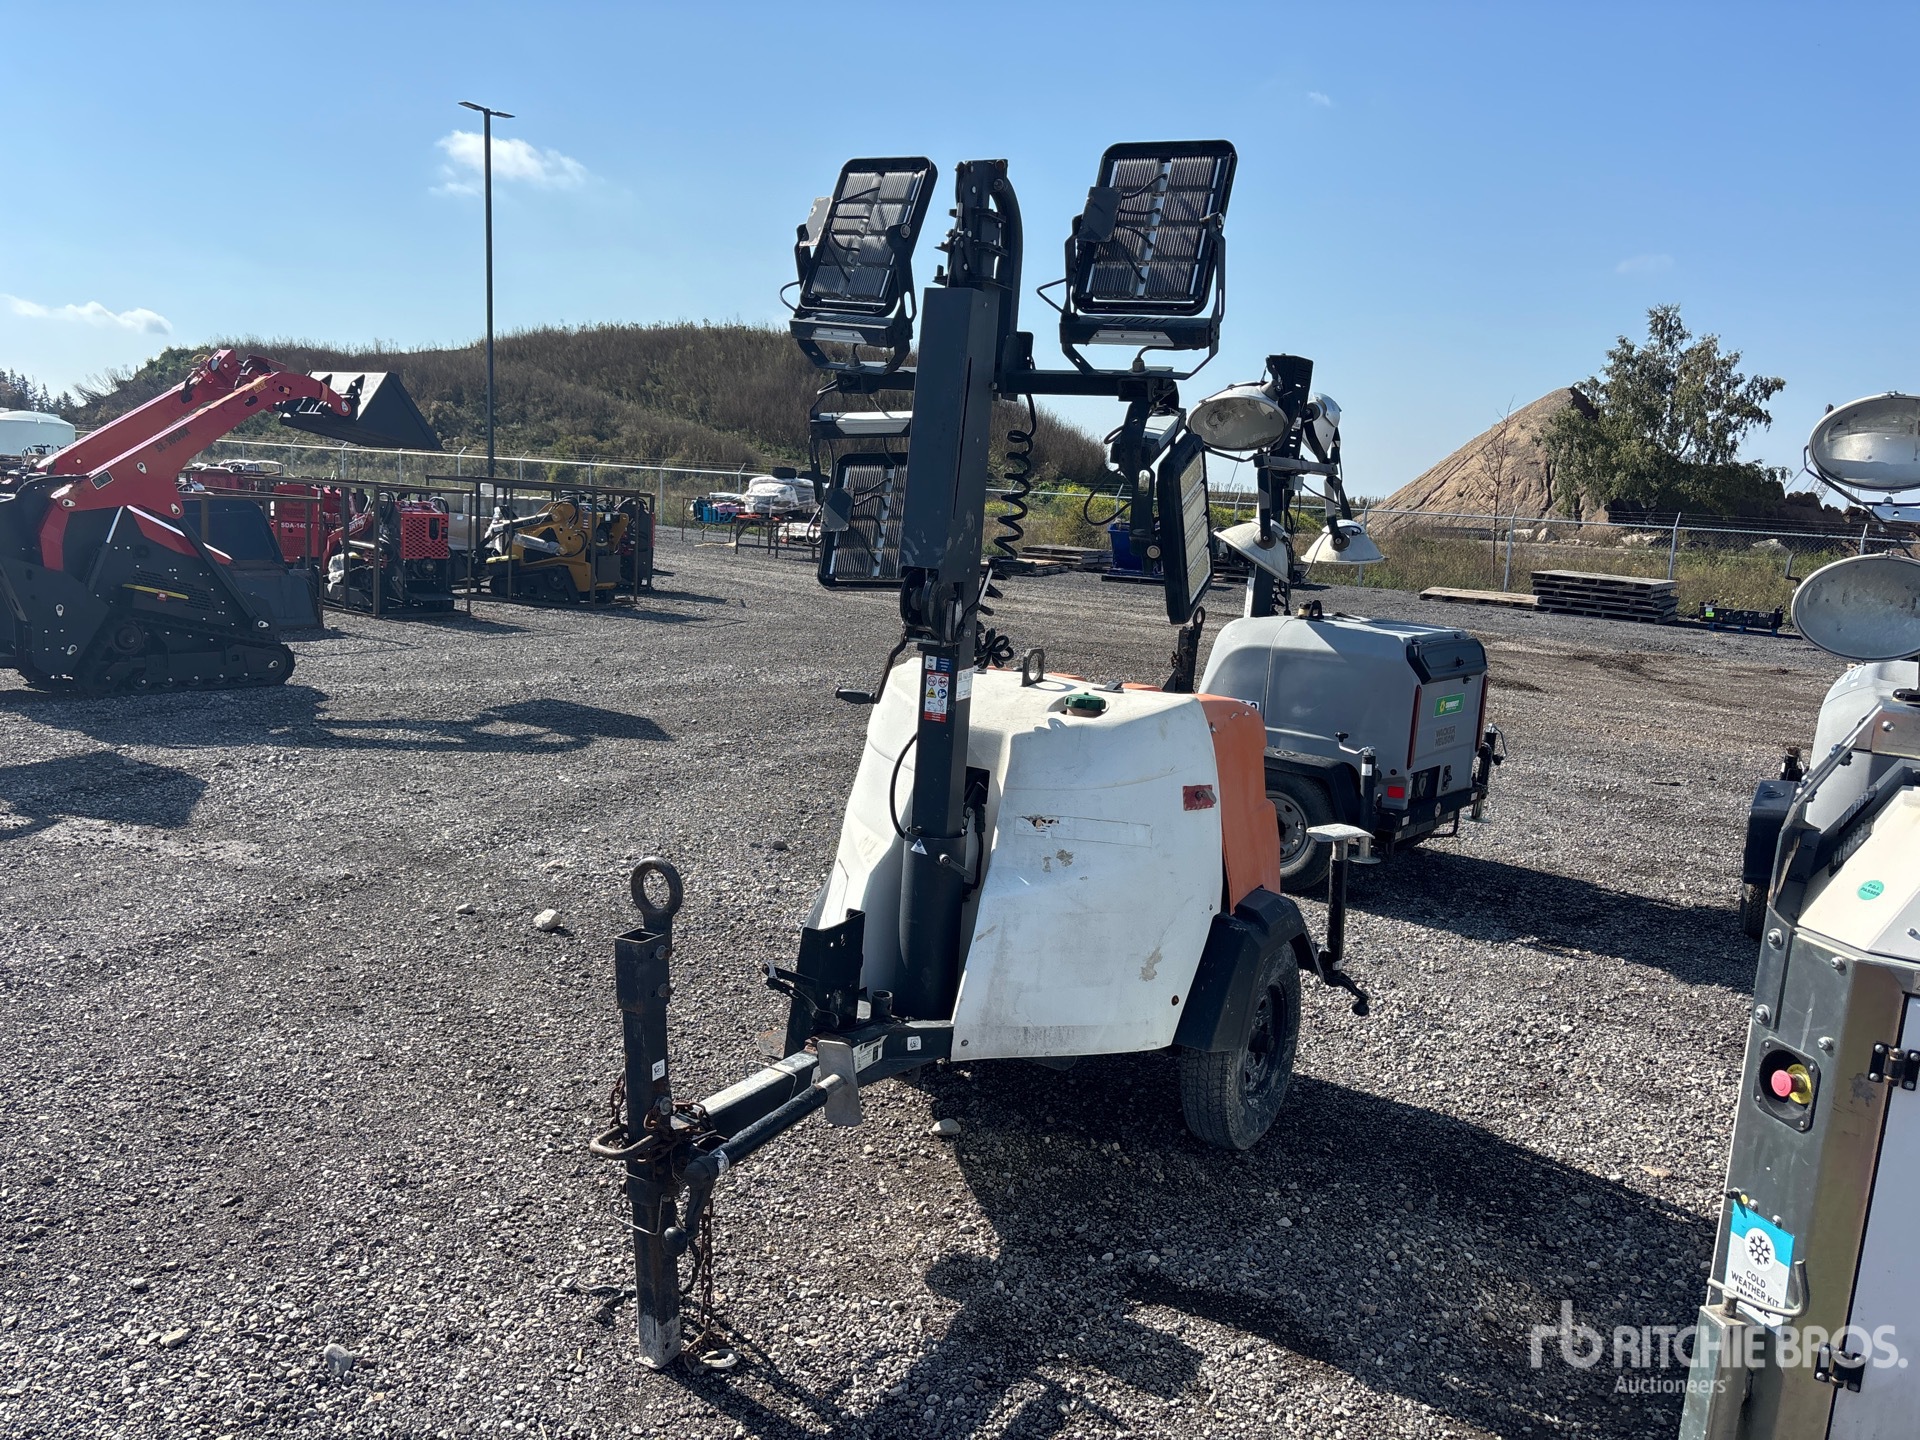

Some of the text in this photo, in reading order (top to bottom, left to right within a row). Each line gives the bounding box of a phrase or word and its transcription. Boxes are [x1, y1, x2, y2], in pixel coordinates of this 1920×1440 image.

[1731, 1270, 1780, 1307] WEATHER KIT
[1746, 1270, 1766, 1289] COLD
